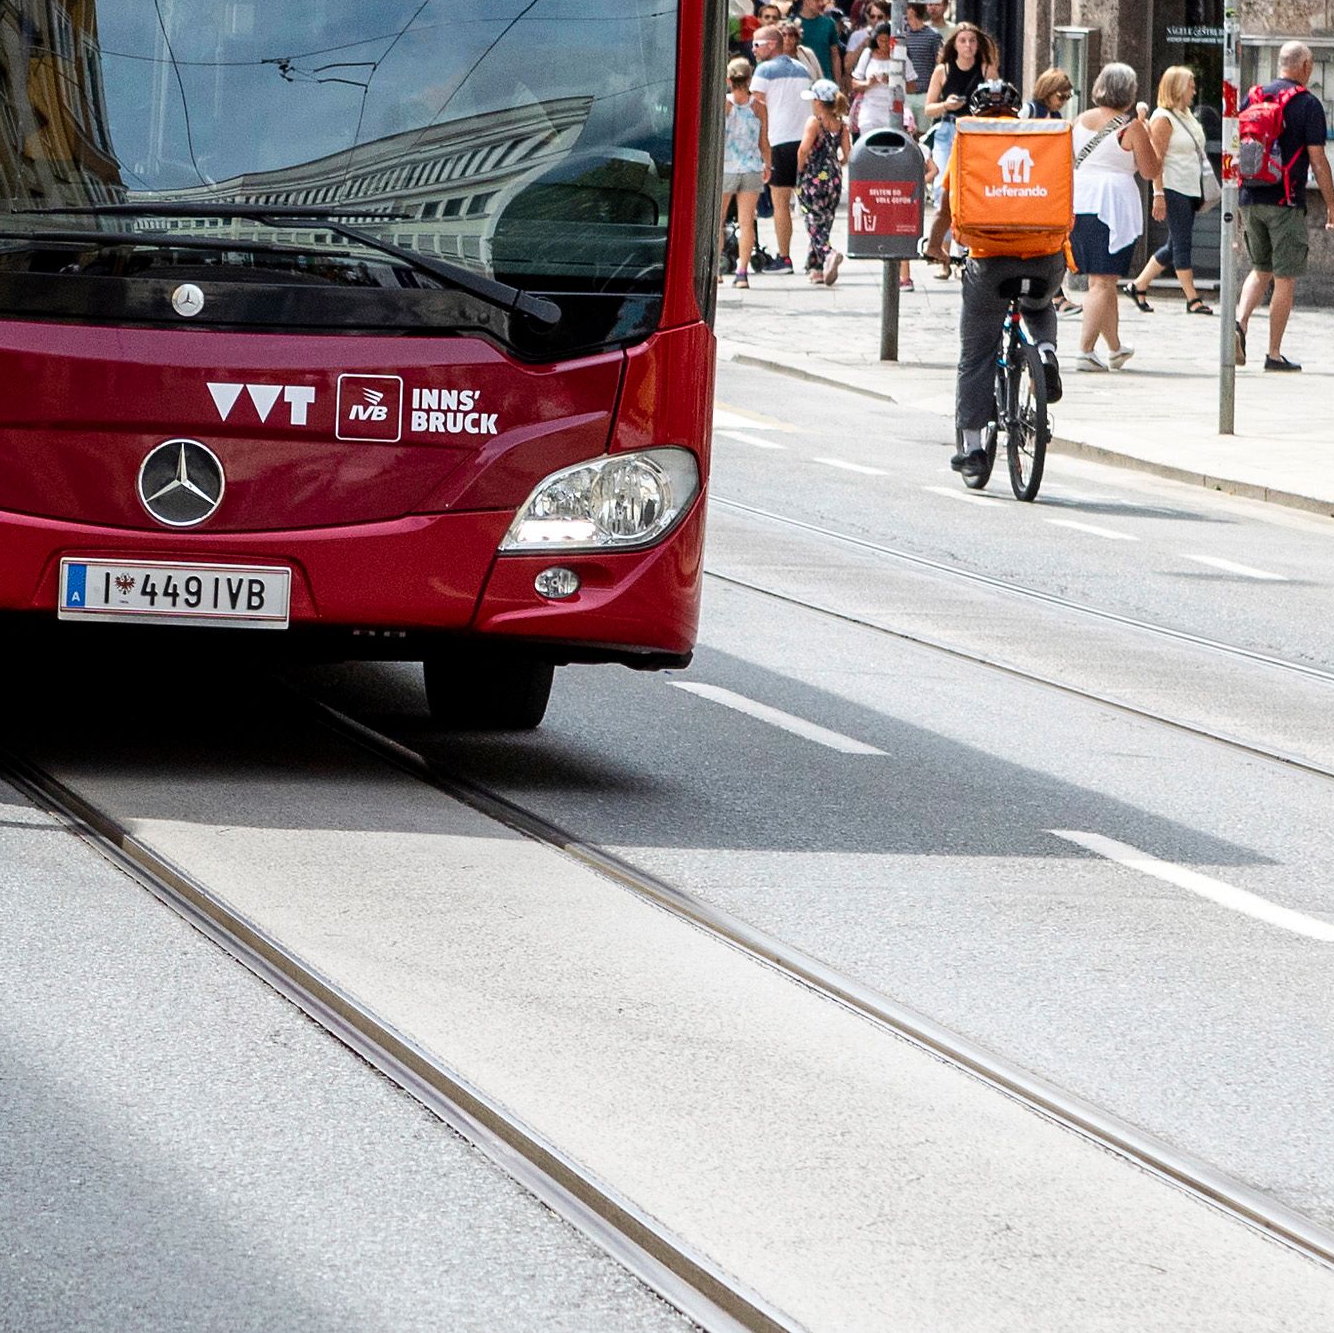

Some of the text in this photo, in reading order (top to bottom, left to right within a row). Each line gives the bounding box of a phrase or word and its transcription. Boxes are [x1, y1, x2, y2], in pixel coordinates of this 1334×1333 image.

[984, 184, 1048, 198] Lieferando
[206, 382, 316, 426] VVT
[411, 388, 481, 411] INNS'
[348, 404, 389, 421] IVB
[410, 410, 499, 436] BRUCK
[71, 591, 82, 603] A
